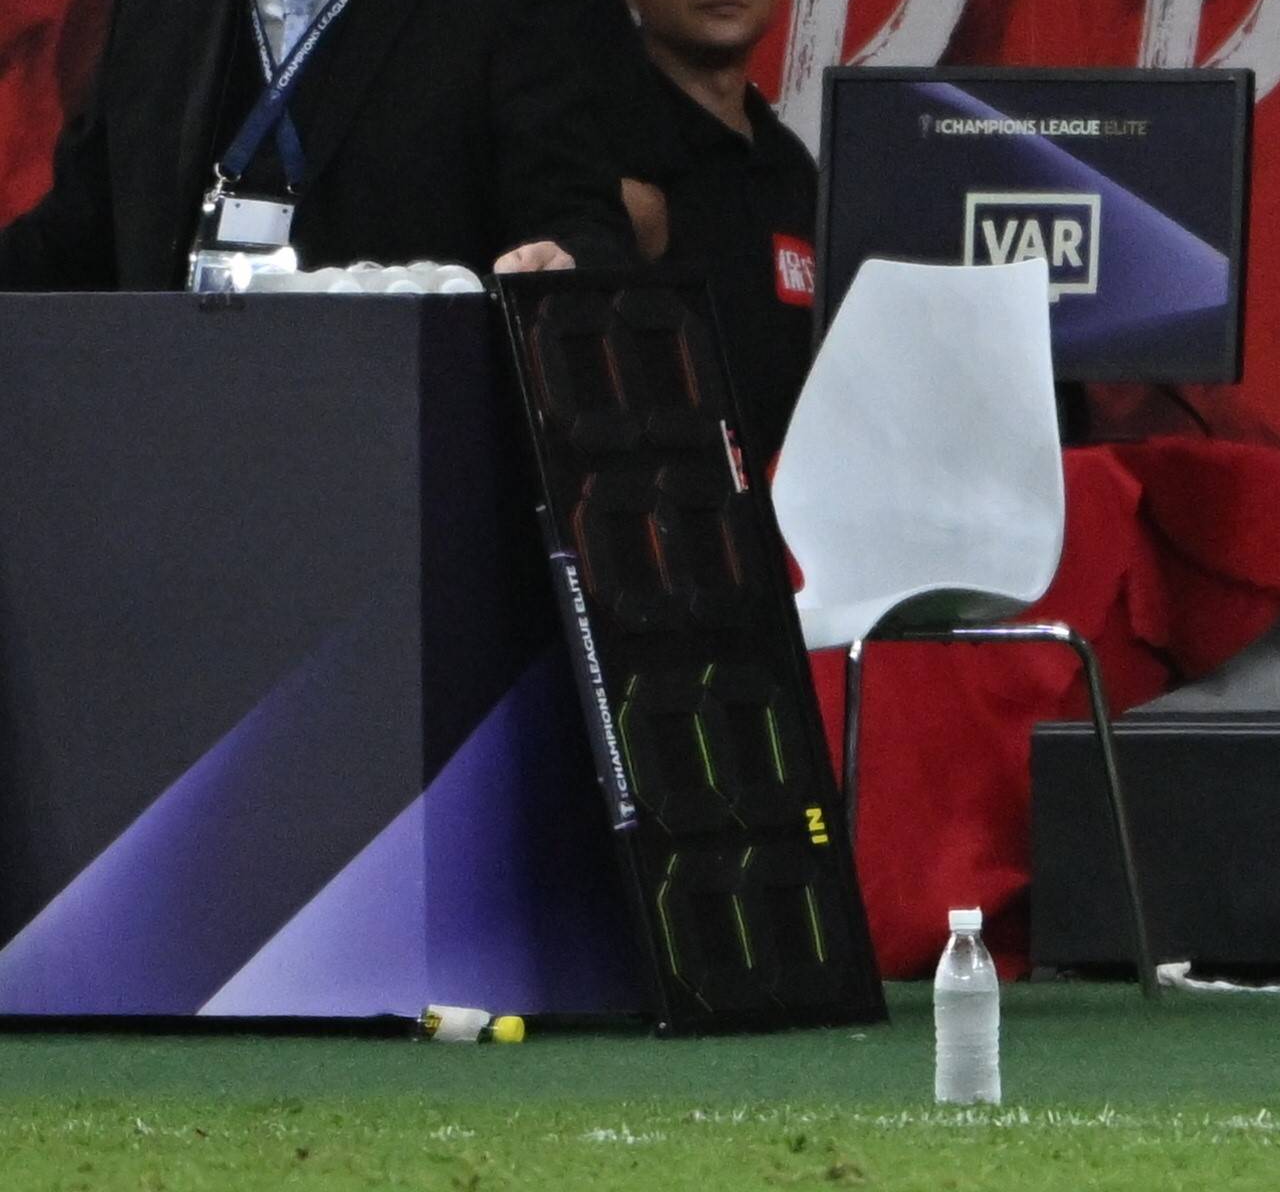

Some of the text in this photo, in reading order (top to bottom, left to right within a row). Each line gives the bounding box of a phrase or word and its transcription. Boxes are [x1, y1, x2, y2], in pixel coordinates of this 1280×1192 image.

[278, 29, 320, 90] CHAMPIONS
[941, 119, 1036, 136] CHAMPIONS
[1040, 120, 1100, 136] LEAGUE
[1104, 120, 1147, 136] ELITE
[981, 219, 1083, 267] VAR
[566, 565, 627, 792] CHAMPIONS LEAGUE ELITE
